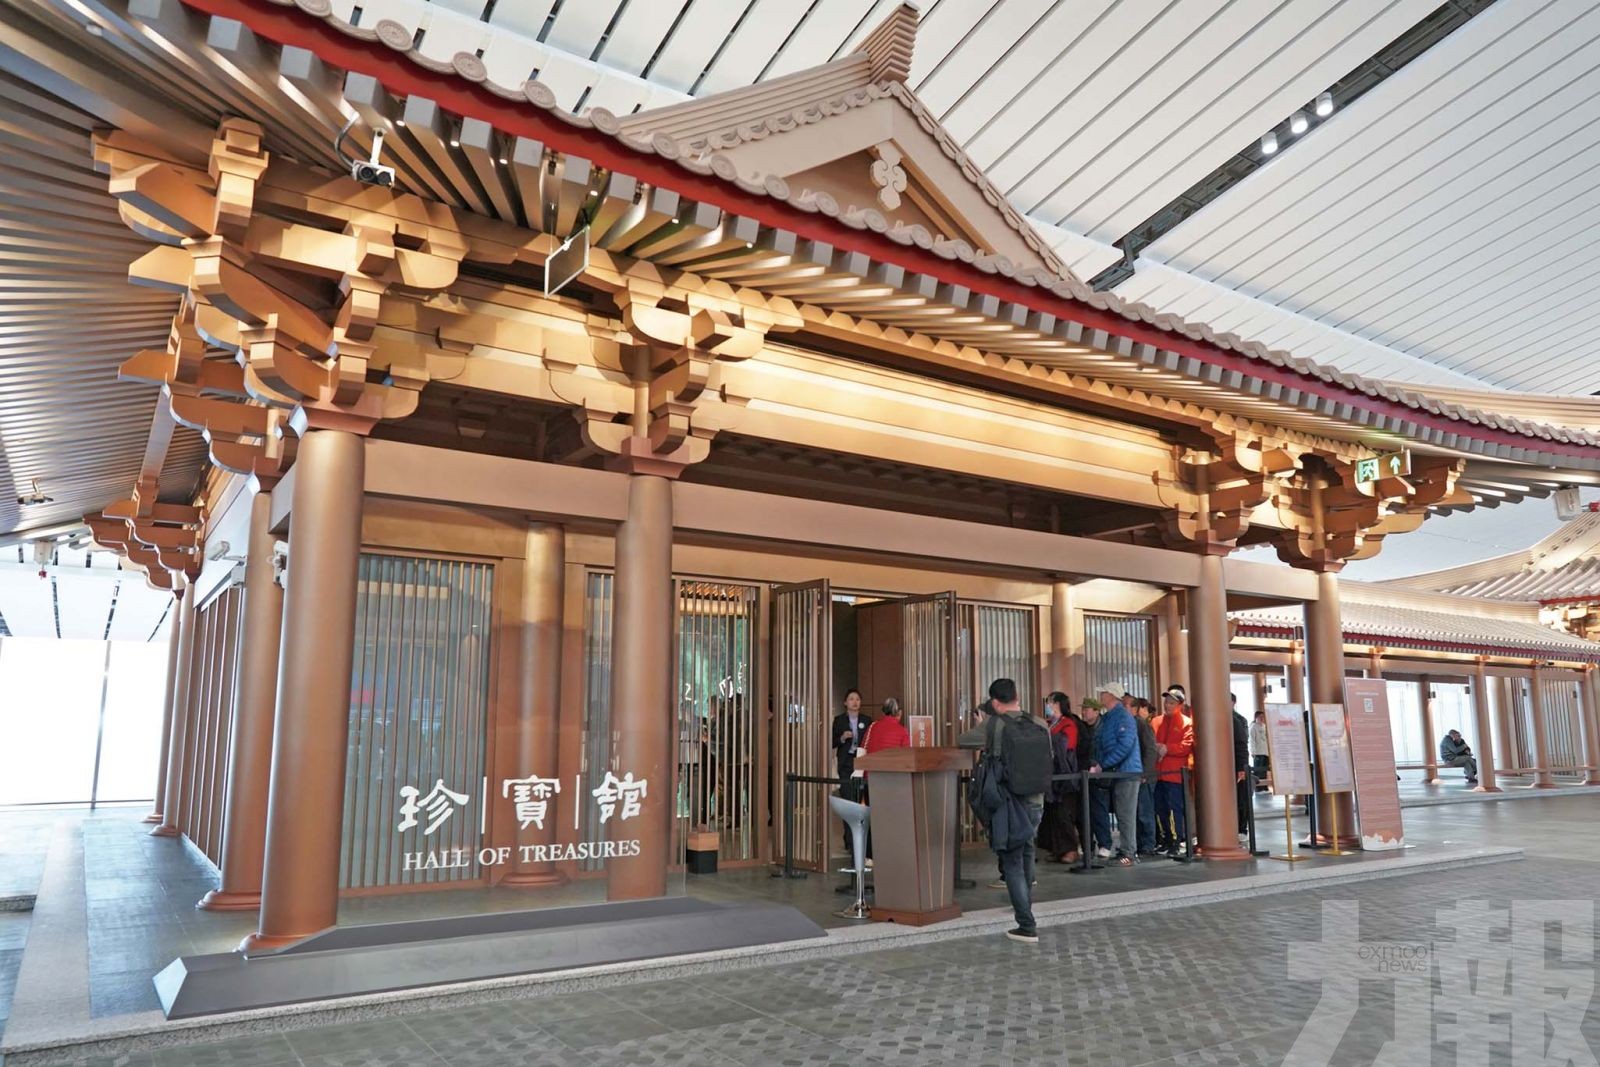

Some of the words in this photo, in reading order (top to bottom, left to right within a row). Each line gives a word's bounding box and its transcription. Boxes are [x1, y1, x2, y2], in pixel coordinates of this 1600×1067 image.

[402, 848, 471, 871] HALL
[478, 846, 512, 866] OF
[519, 839, 641, 864] TREASURES
